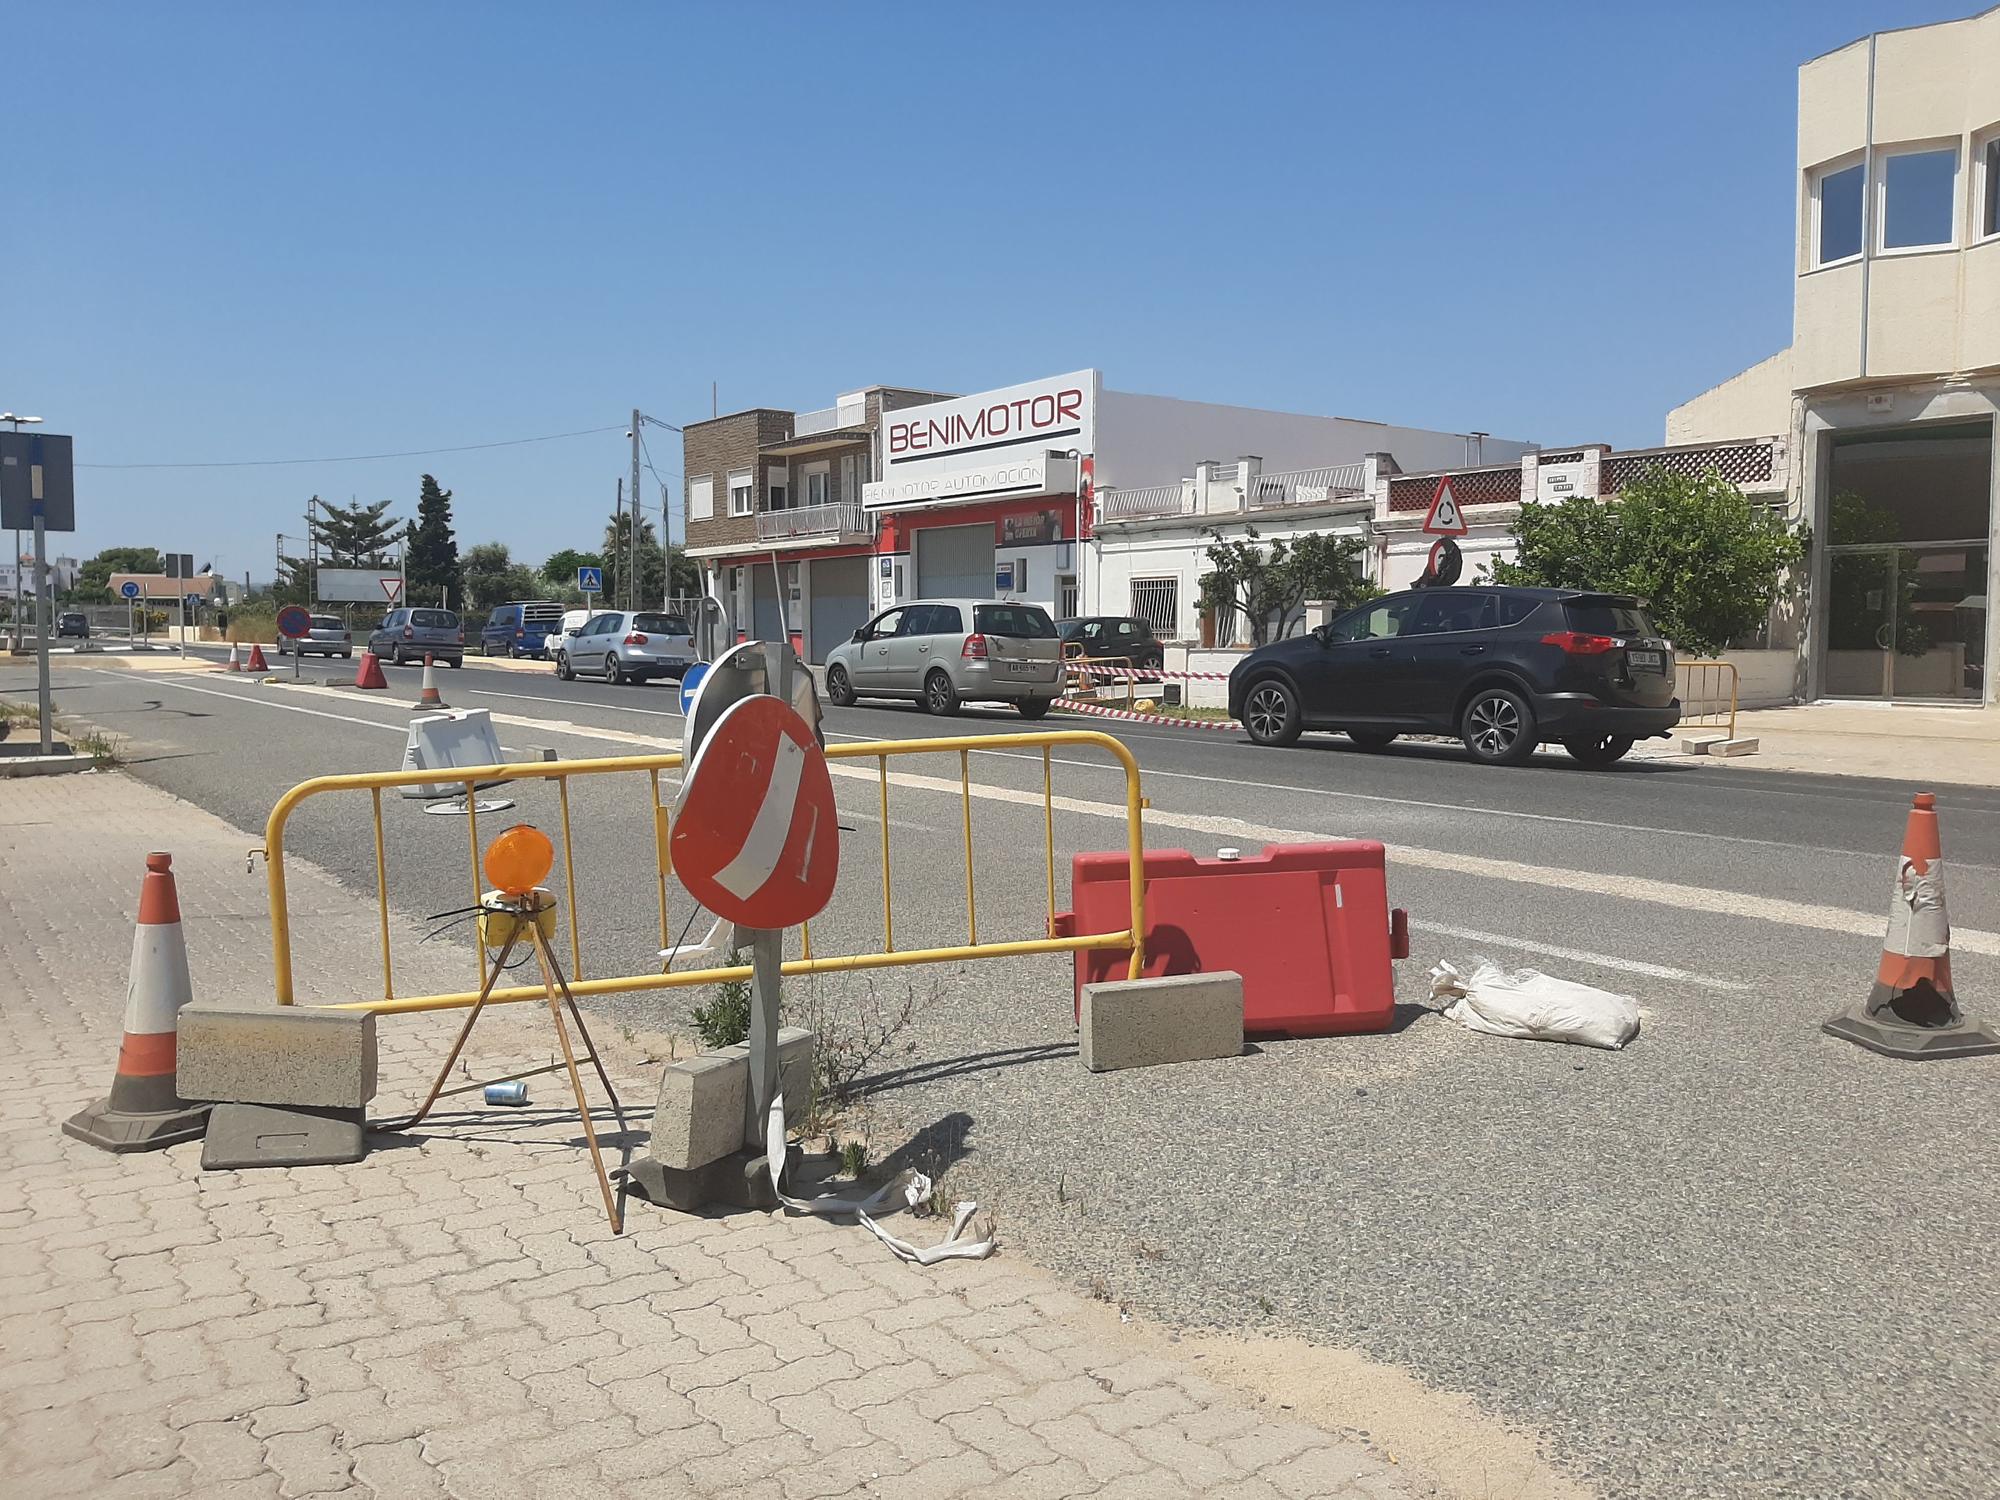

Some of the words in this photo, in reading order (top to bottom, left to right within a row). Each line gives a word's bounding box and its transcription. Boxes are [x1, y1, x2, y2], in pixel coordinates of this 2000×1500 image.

[890, 389, 1083, 454] BENIMOTOR
[864, 480, 940, 500] BENIOTOR
[944, 463, 1043, 491] AUTOMOCIÓN
